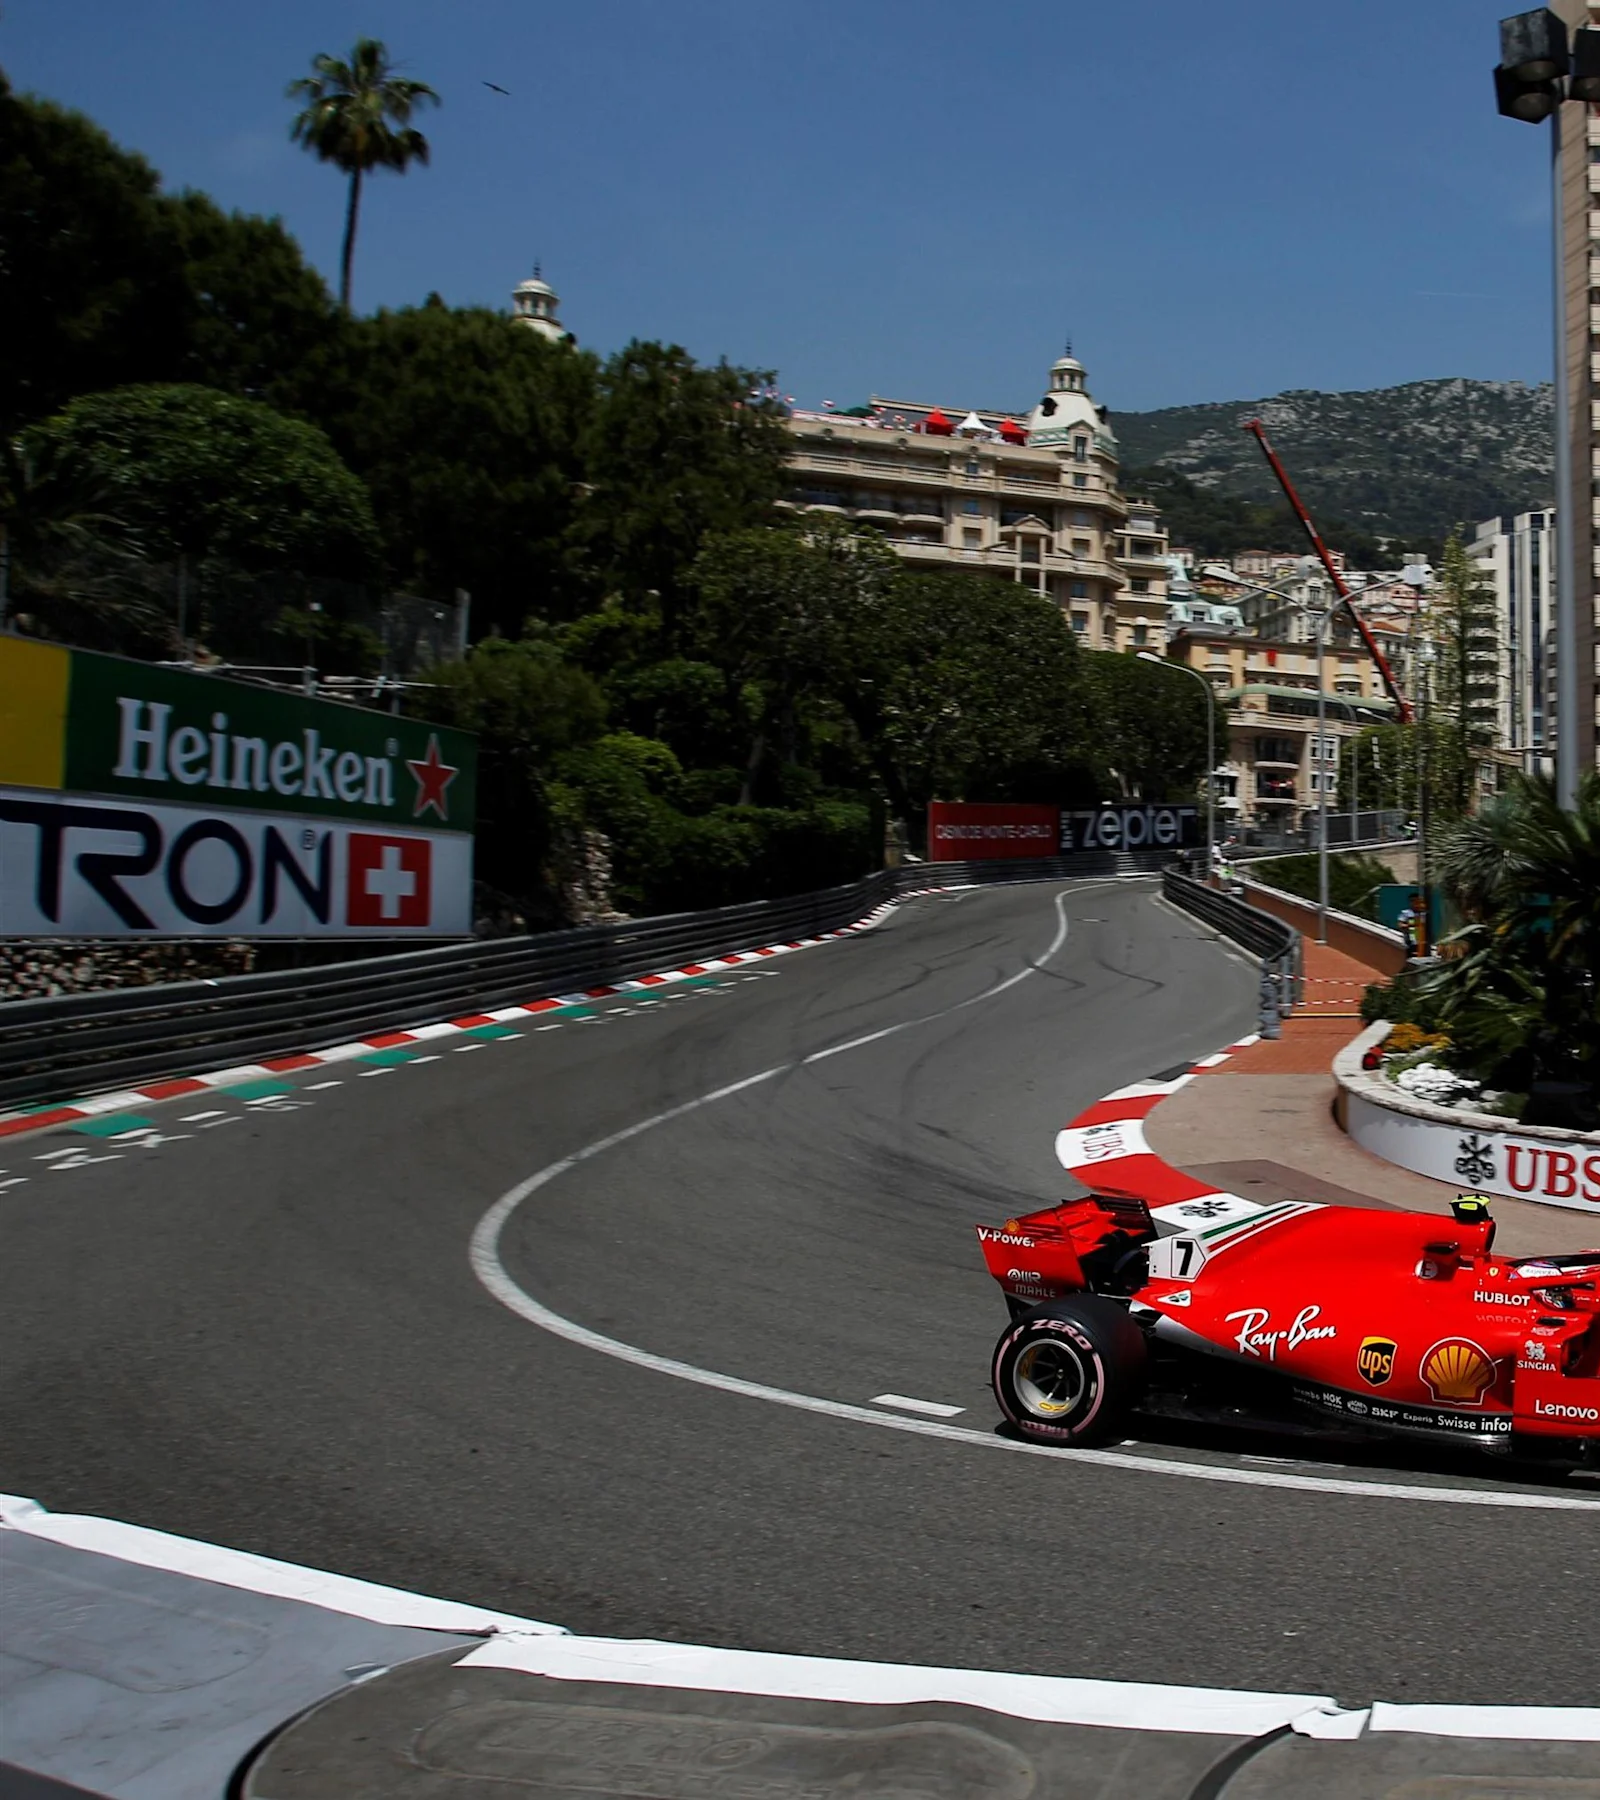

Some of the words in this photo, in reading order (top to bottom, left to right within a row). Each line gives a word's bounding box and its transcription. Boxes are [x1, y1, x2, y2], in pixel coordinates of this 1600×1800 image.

[112, 697, 396, 807] Heineken
[1073, 804, 1196, 851] zepter
[977, 1227, 1036, 1248] V-Powe
[1176, 1241, 1193, 1276] 7
[1015, 1284, 1057, 1299] MAHLE
[1473, 1290, 1531, 1307] HUBLOT
[1029, 1319, 1094, 1352] ZERO
[1360, 1348, 1392, 1379] ups
[1516, 1359, 1557, 1372] SINGHA
[1371, 1406, 1400, 1419] SKF
[1535, 1398, 1600, 1421] Lenovo
[1437, 1414, 1477, 1430] Swisse
